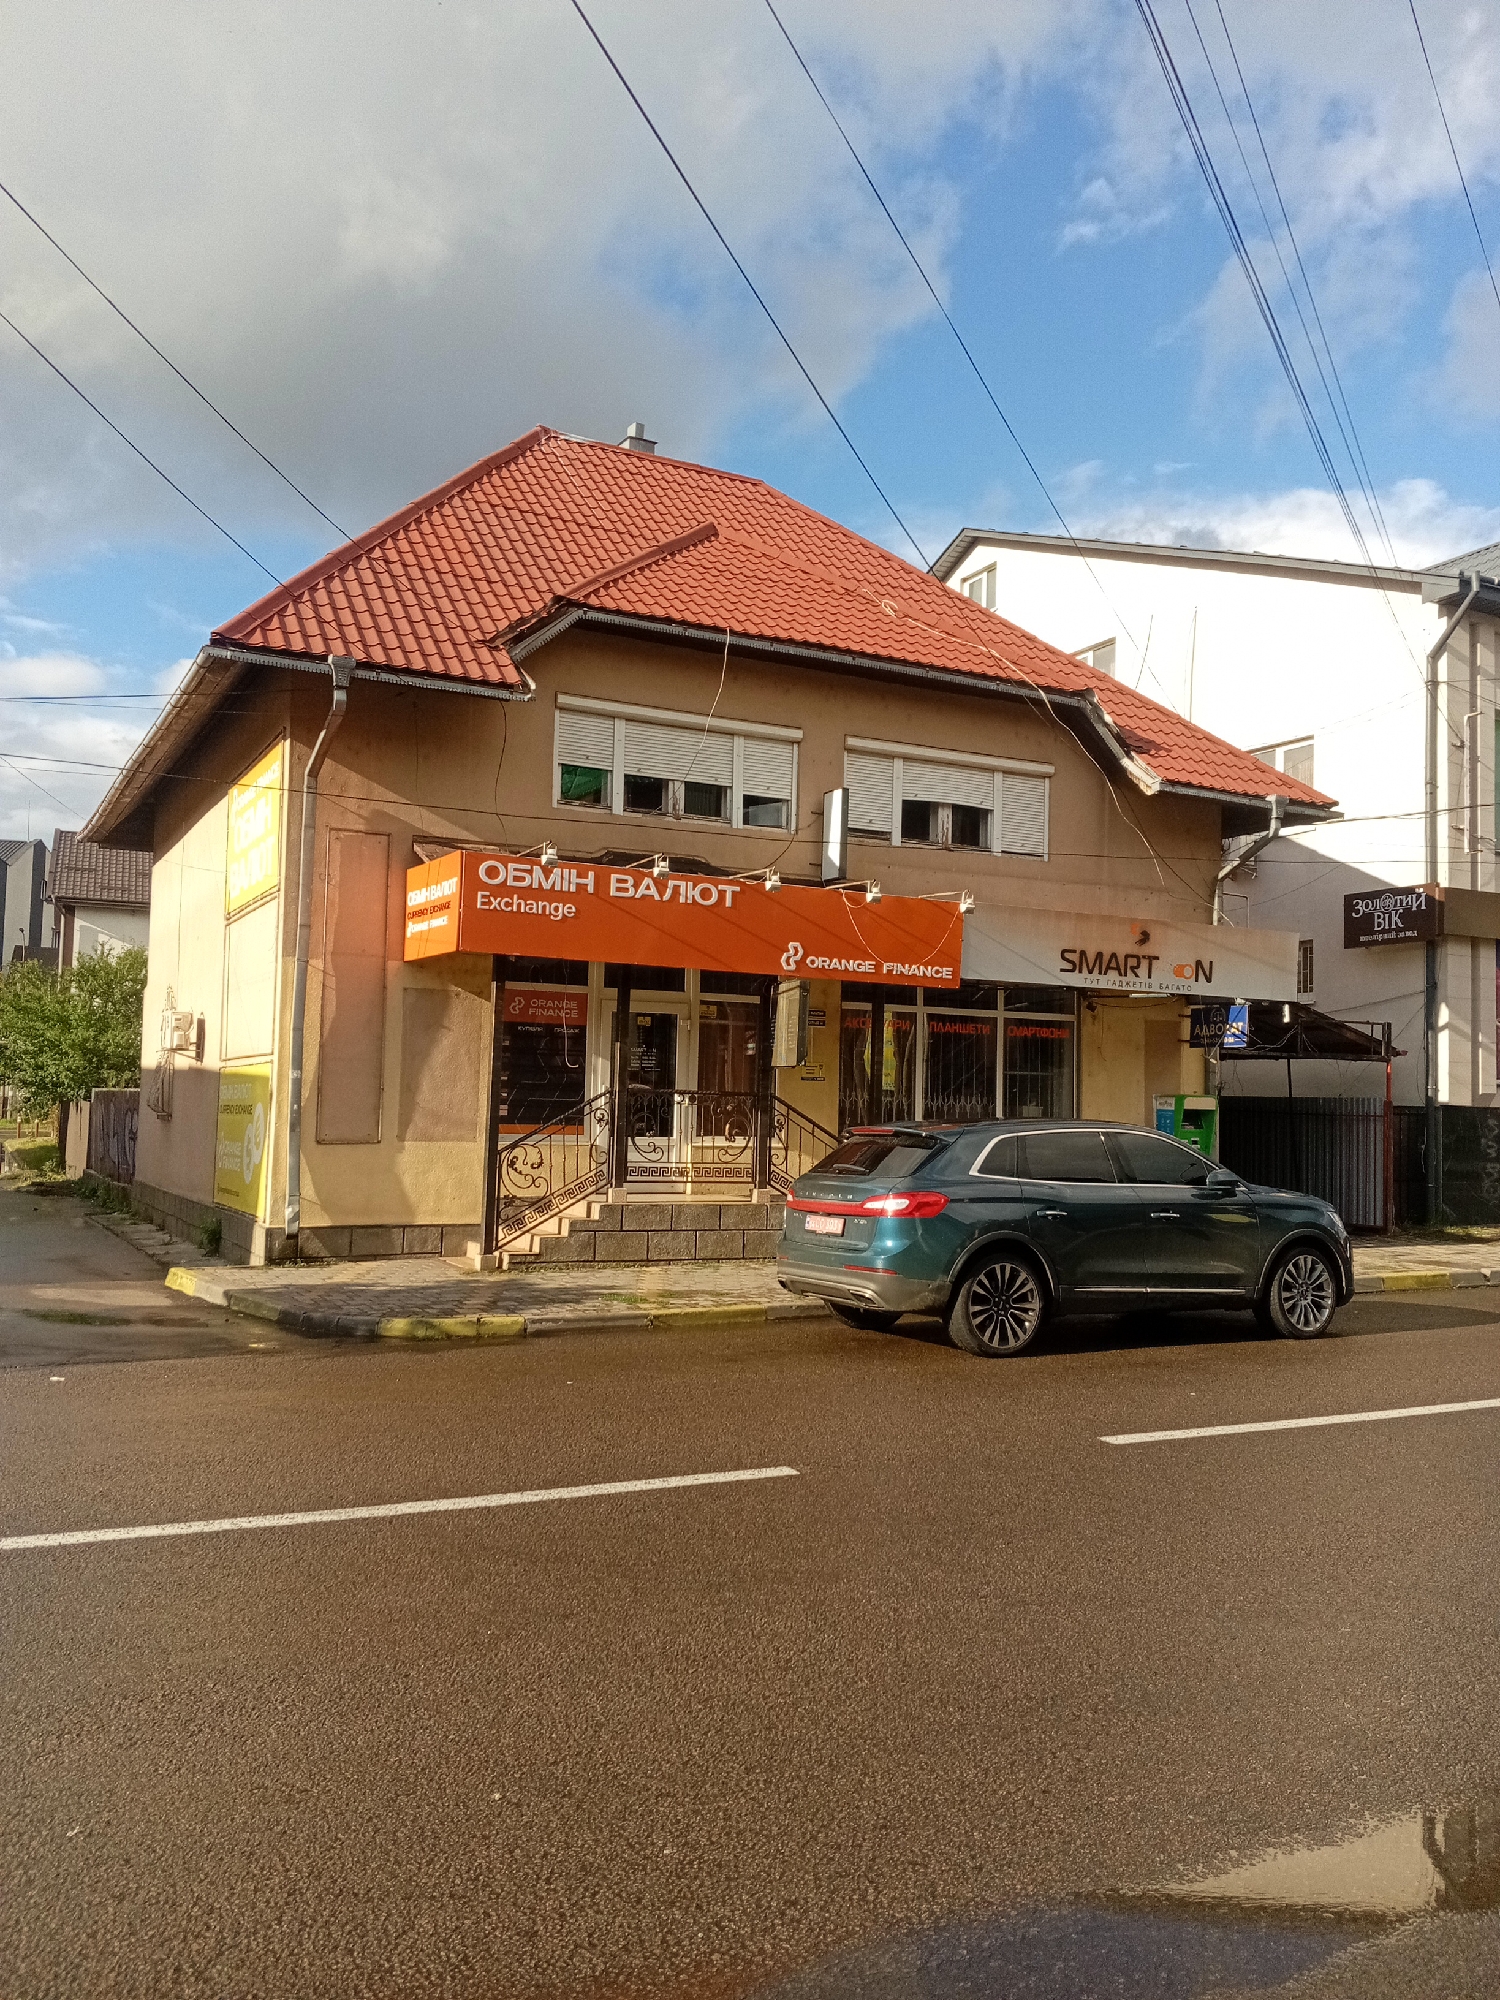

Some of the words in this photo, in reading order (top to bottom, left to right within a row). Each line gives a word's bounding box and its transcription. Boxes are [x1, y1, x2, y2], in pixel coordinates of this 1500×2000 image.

[478, 860, 595, 894] ОБМІН
[610, 873, 741, 908] ВАЛЮТ
[476, 891, 576, 921] Exchange
[1373, 908, 1405, 931] ВІК
[806, 955, 876, 973] ORANGE
[883, 962, 953, 980] FINANCE
[1059, 948, 1160, 979] SMART
[1084, 977, 1101, 986] ТУТ
[1106, 979, 1153, 989] ГАДЖЕТІВ
[1159, 983, 1192, 992] БАГАТО
[530, 998, 578, 1009] ORANGE
[528, 1008, 579, 1018] FINANCE
[929, 1021, 991, 1035] ПЛАНШЕТИ
[1007, 1025, 1070, 1039] СМАРТФОНИ
[1193, 1021, 1244, 1037] АДВОКАТ
